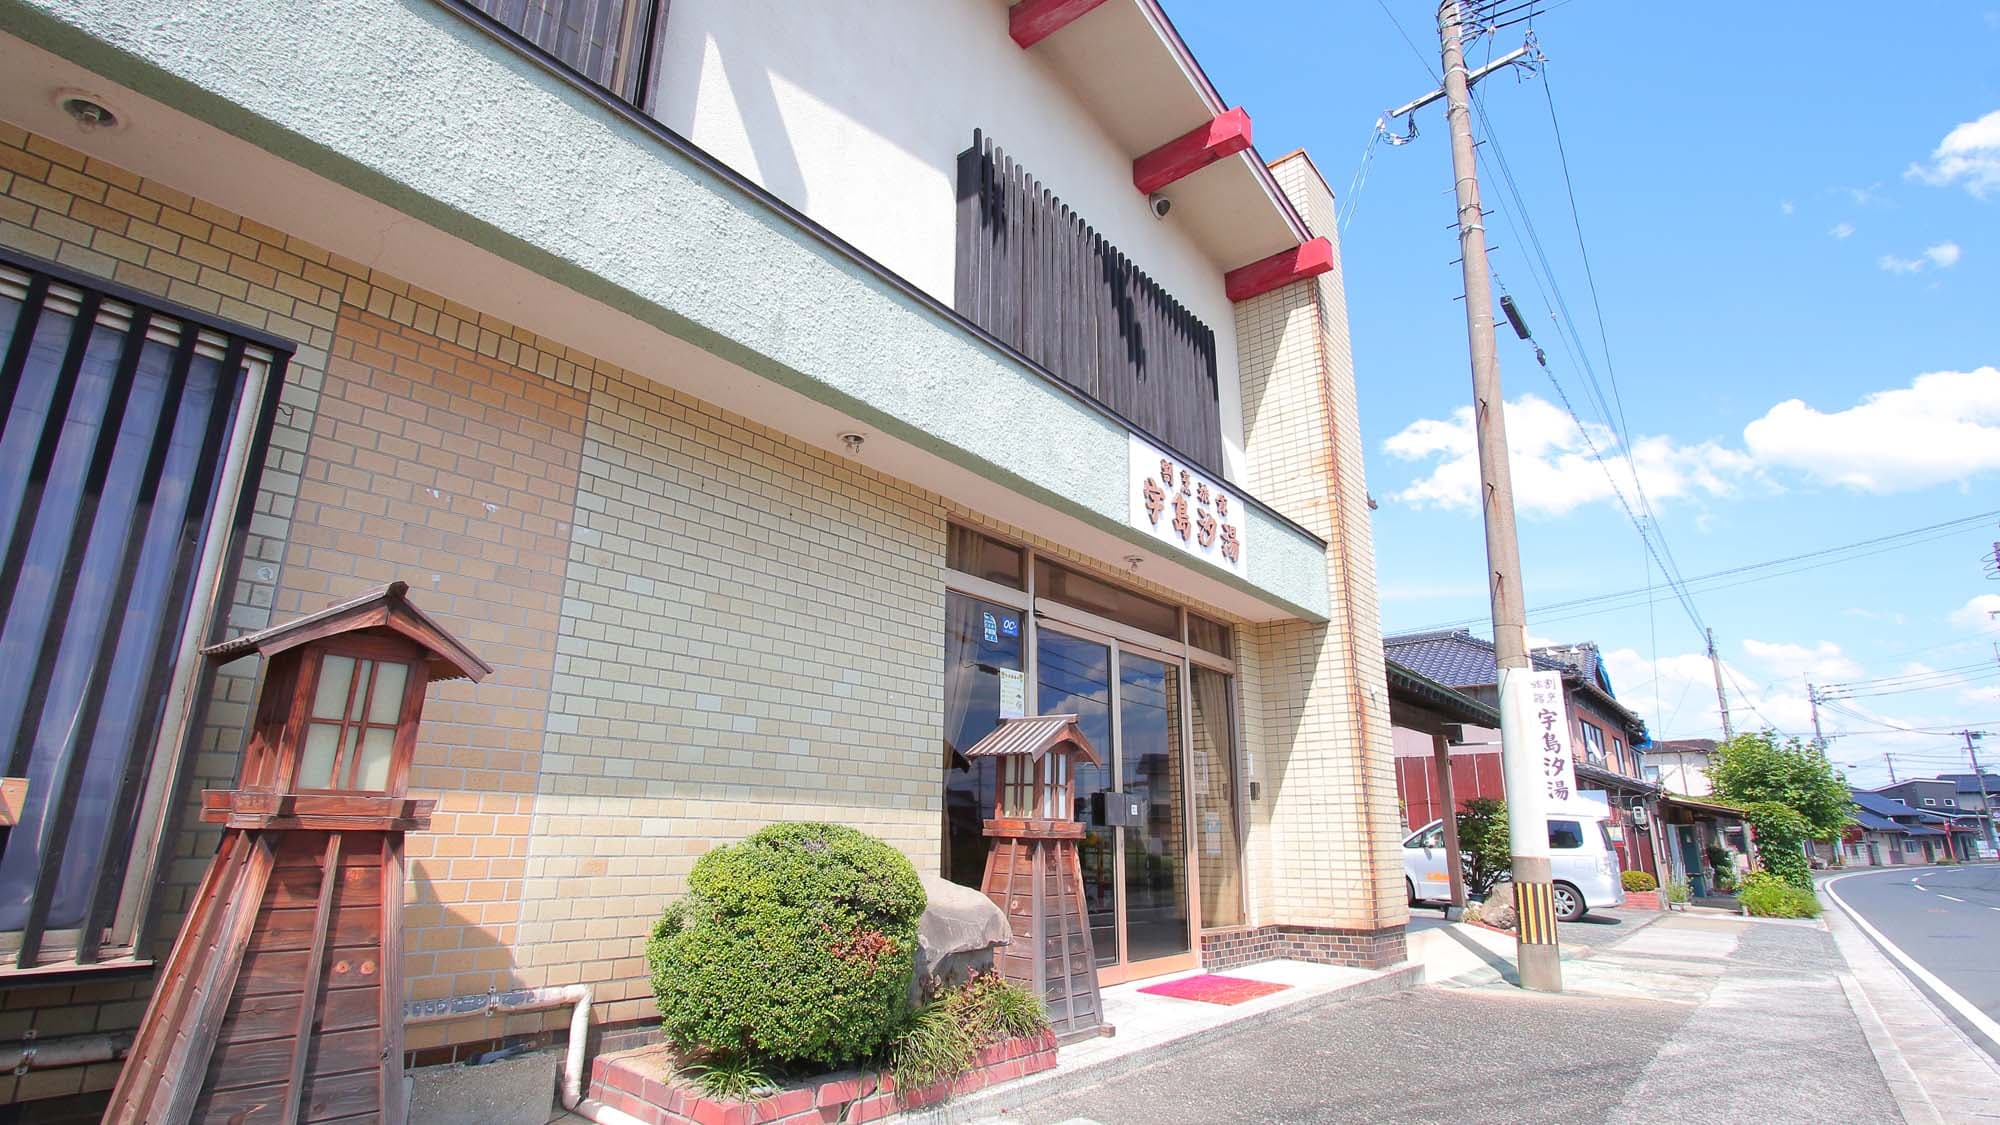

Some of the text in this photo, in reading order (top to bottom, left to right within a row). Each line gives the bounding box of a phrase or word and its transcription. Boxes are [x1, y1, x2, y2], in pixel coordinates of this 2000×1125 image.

[1143, 477, 1240, 563] 宇島汐湯
[1538, 708, 1569, 801] 宇島汐湯
